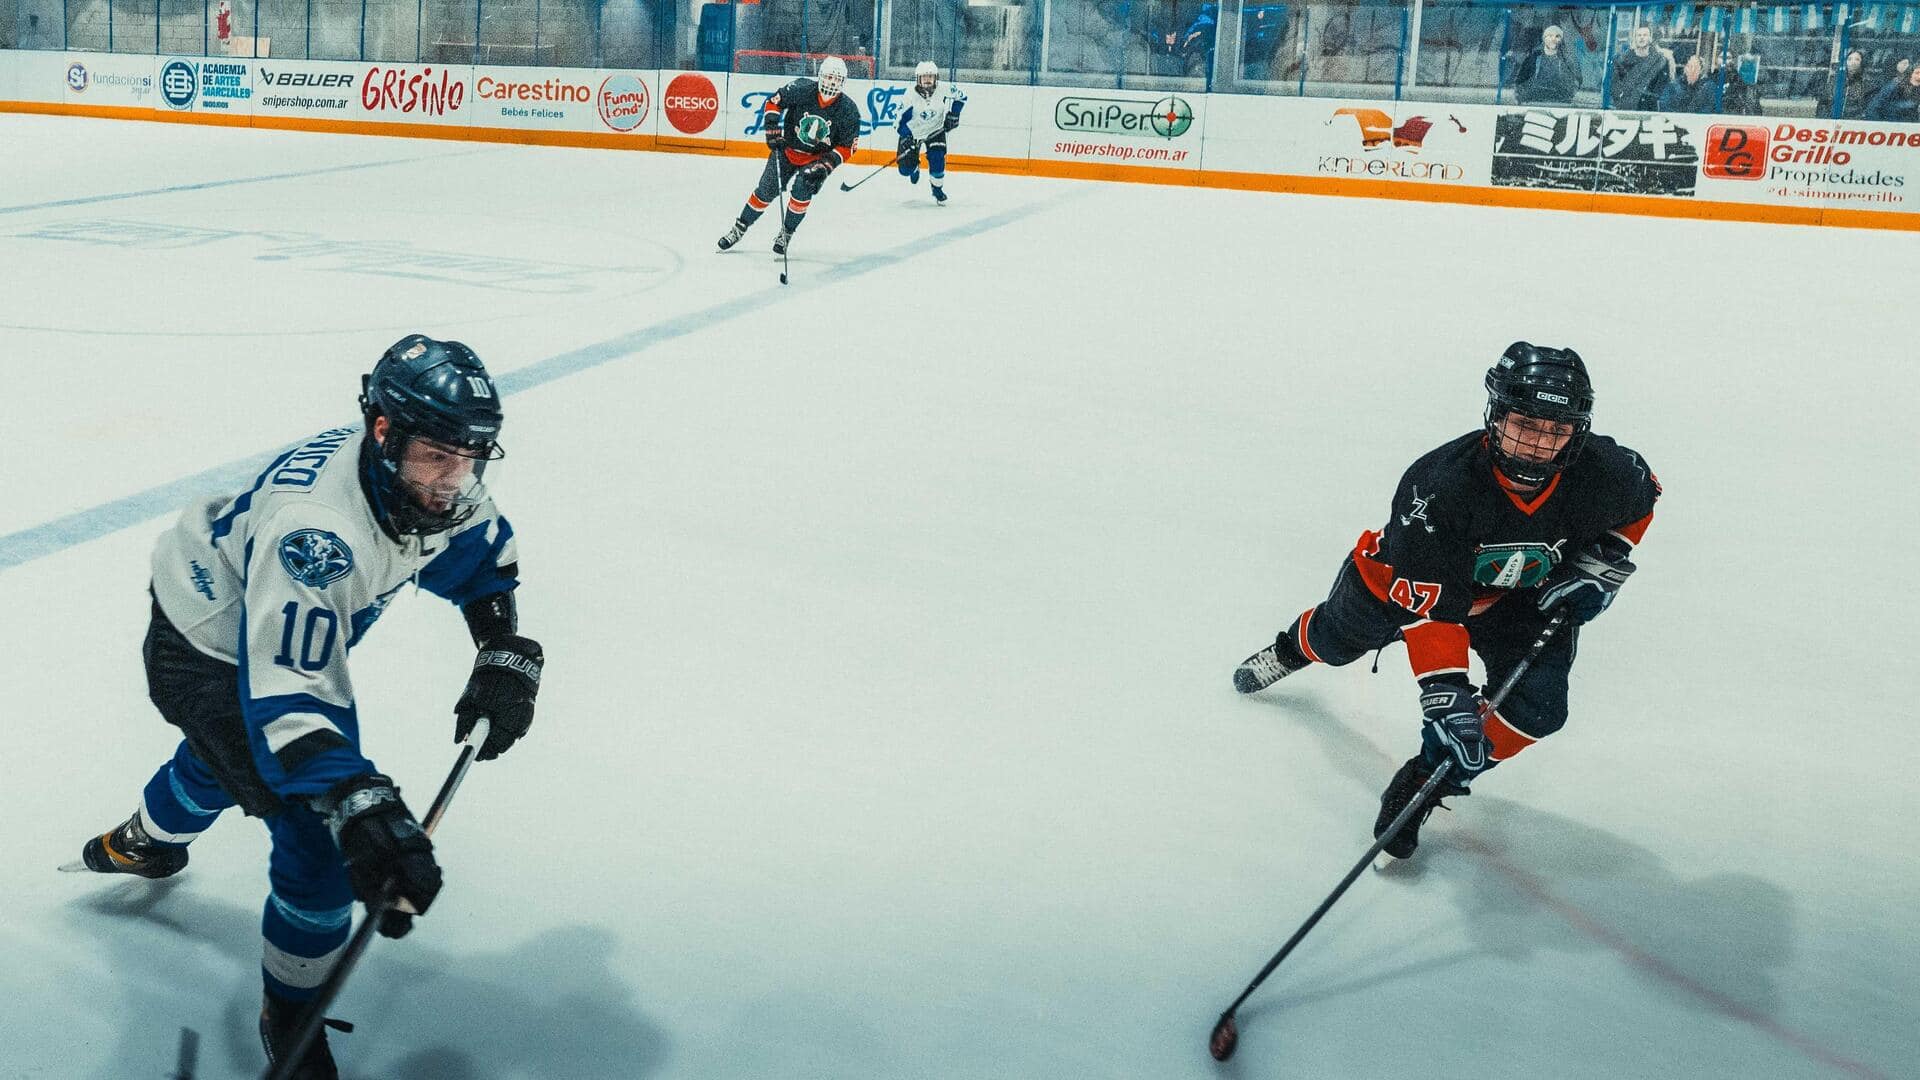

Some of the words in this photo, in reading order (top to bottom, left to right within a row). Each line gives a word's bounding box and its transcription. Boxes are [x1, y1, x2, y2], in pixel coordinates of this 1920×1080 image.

[203, 64, 247, 75] ACADEMIA
[203, 75, 213, 85] DE
[214, 76, 241, 86] ARTES
[203, 87, 251, 98] MARCIALES
[477, 77, 591, 103] Carestino
[604, 91, 644, 107] Funny
[262, 95, 348, 109] snipershop.com.ar
[665, 97, 717, 110] CRESKO
[531, 108, 564, 118] Felices
[1773, 123, 1920, 147] Desimone
[1054, 140, 1189, 162] snipershop.com.ar
[1770, 144, 1851, 165] Grillo
[1770, 166, 1904, 187] Propiedades
[466, 376, 492, 399] 10
[1537, 391, 1569, 405] CCM
[1389, 577, 1442, 621] 47
[274, 601, 337, 672] 10
